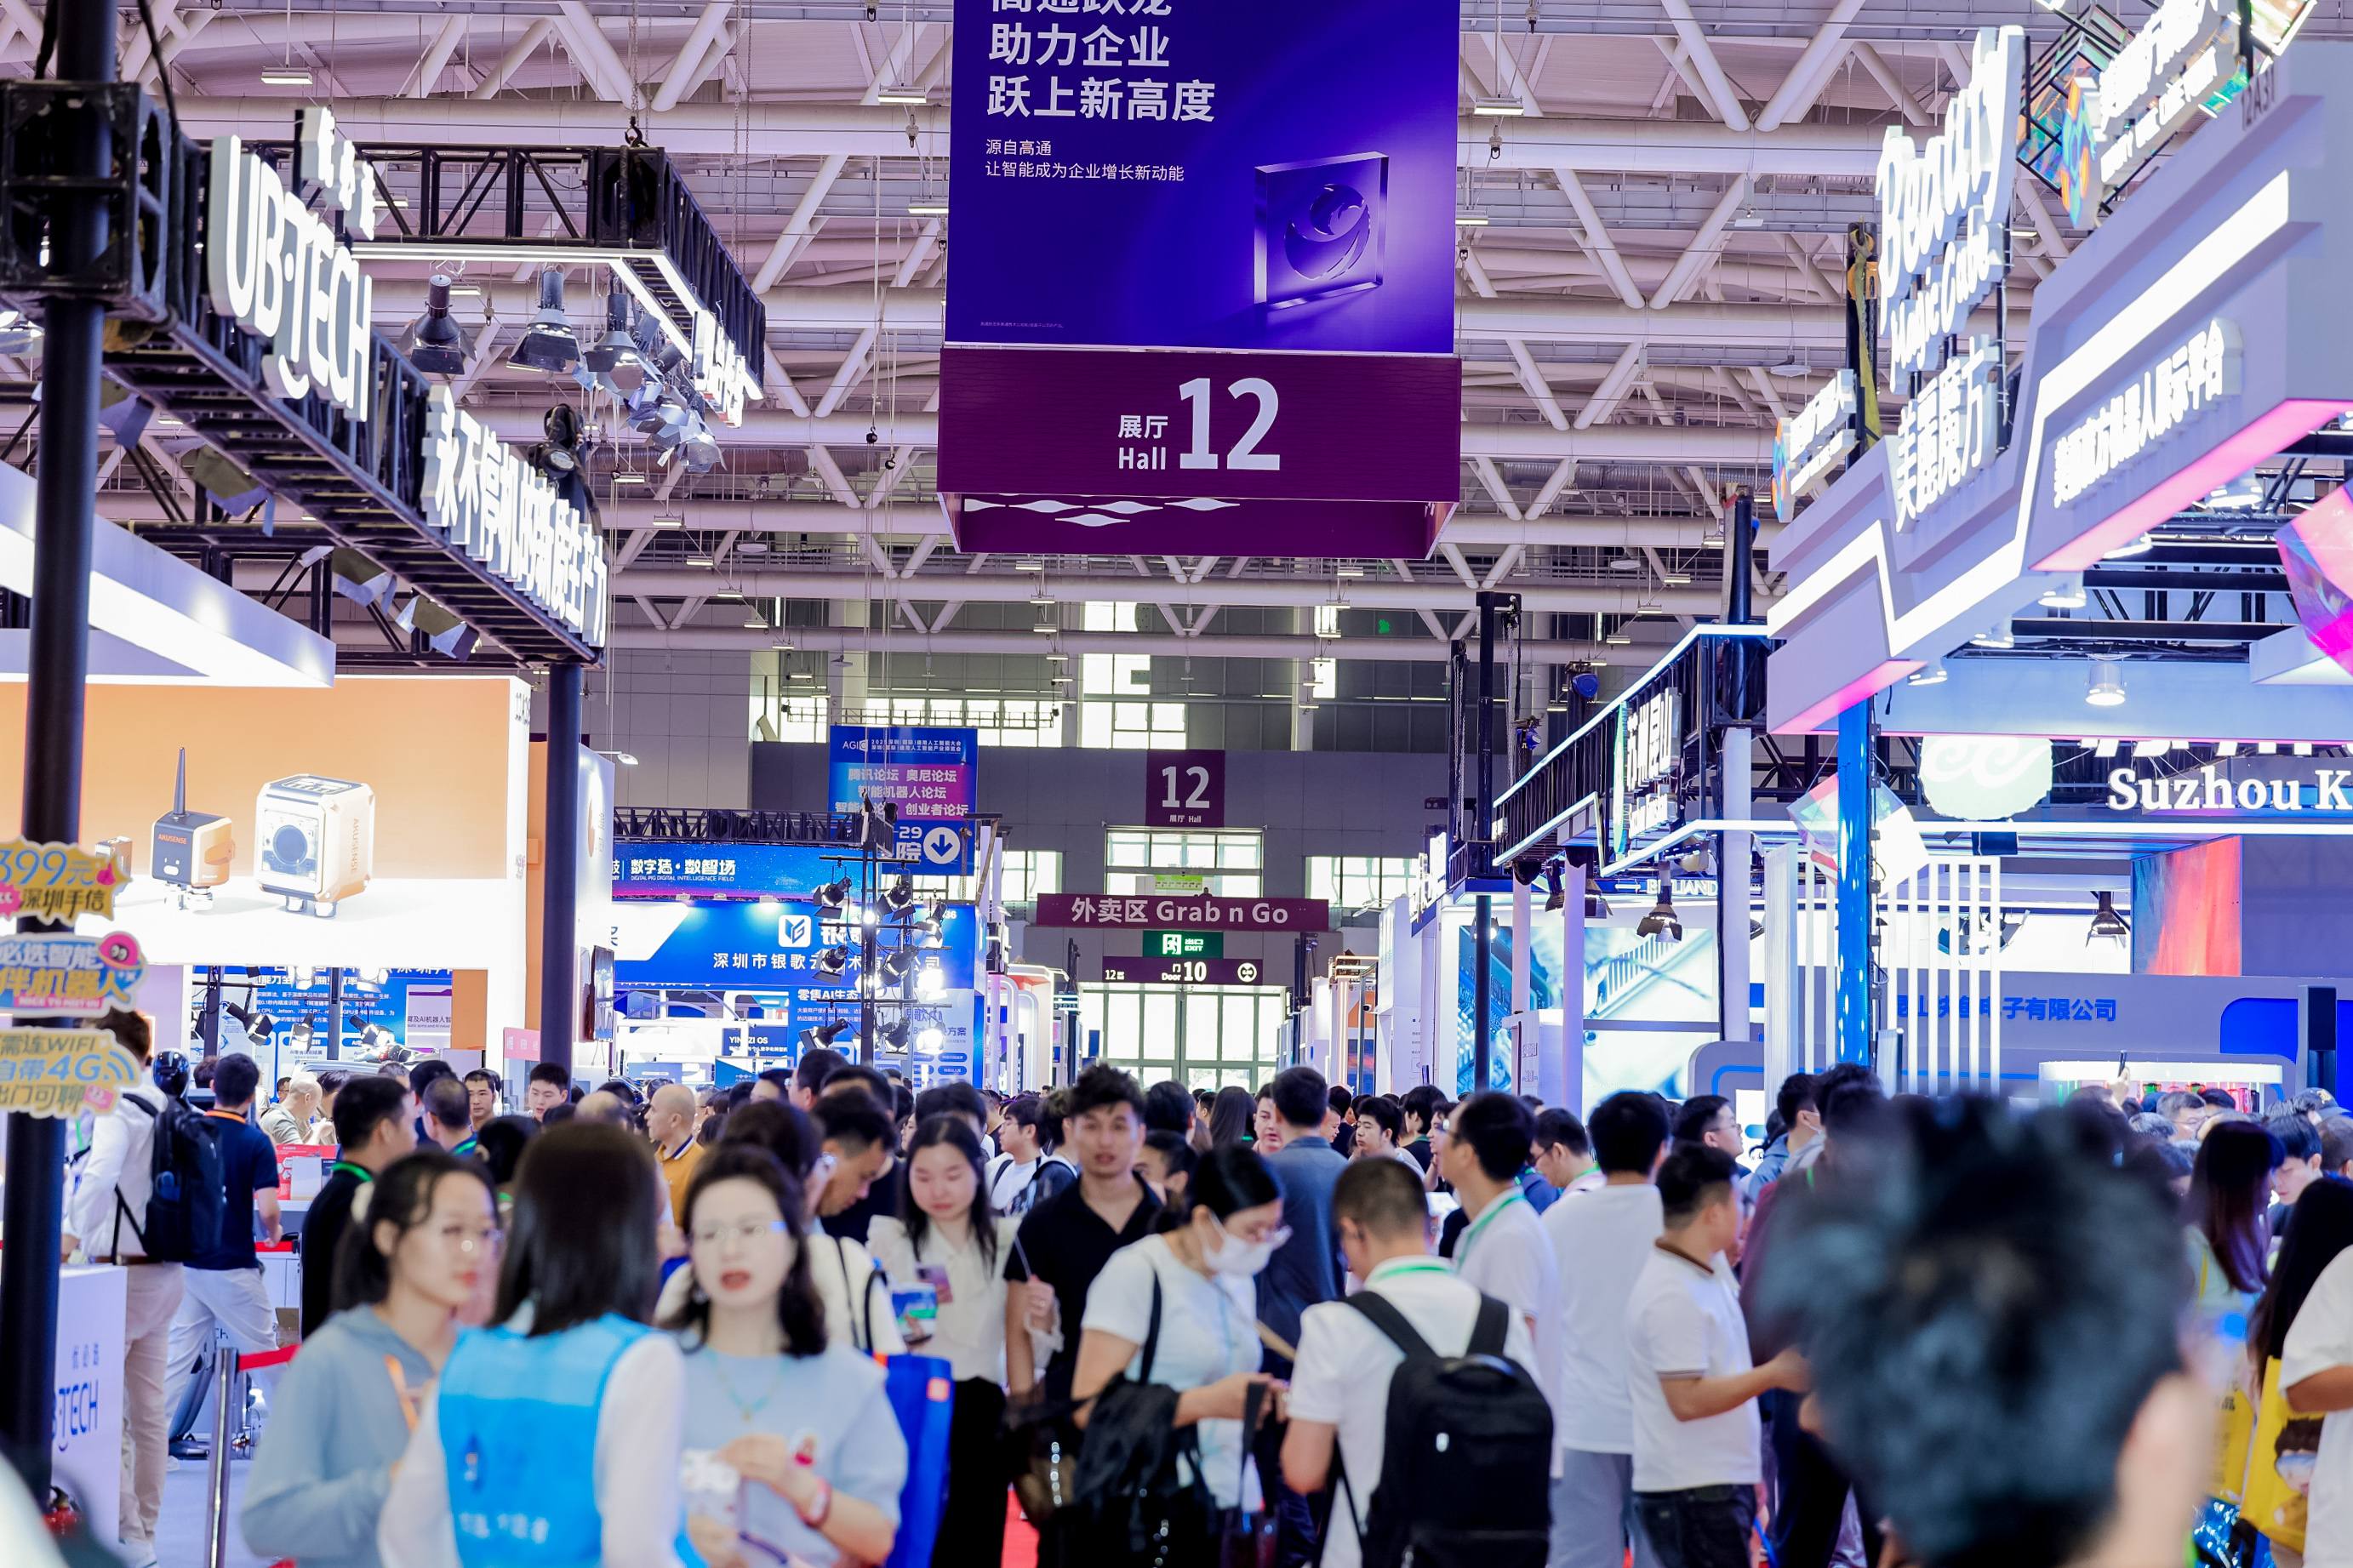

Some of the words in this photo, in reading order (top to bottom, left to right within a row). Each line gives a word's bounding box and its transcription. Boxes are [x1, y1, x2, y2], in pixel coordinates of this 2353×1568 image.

[989, 22, 1170, 67] 助力企业
[986, 75, 1215, 123] 跃上新高度
[985, 139, 1052, 157] 源自高通
[985, 161, 1185, 182] 让智能成为企业增长新动能
[1117, 414, 1168, 439] 展厅
[1179, 377, 1280, 470] 12
[1118, 447, 1167, 470] Hall
[848, 769, 900, 781] 腾讯论坛
[906, 770, 957, 783] 奥尼论坛
[1162, 766, 1210, 809] 12
[2108, 766, 2302, 811] Suzhou
[905, 803, 968, 817] 创业者论坛
[1169, 814, 1185, 823] 展厅
[1188, 814, 1202, 824] Hall
[158, 833, 187, 845] AKUSENSE
[351, 818, 361, 874] AKUSENSE
[1071, 898, 1148, 923] 外卖区
[1157, 901, 1220, 922] Grab
[1229, 908, 1242, 922] n
[1252, 903, 1288, 924] Go
[1105, 970, 1116, 980] 12
[1162, 972, 1181, 981] Door
[1173, 963, 1181, 972] 门
[1184, 961, 1207, 982] 10
[729, 1036, 756, 1045] YINZI
[757, 1036, 768, 1045] OS
